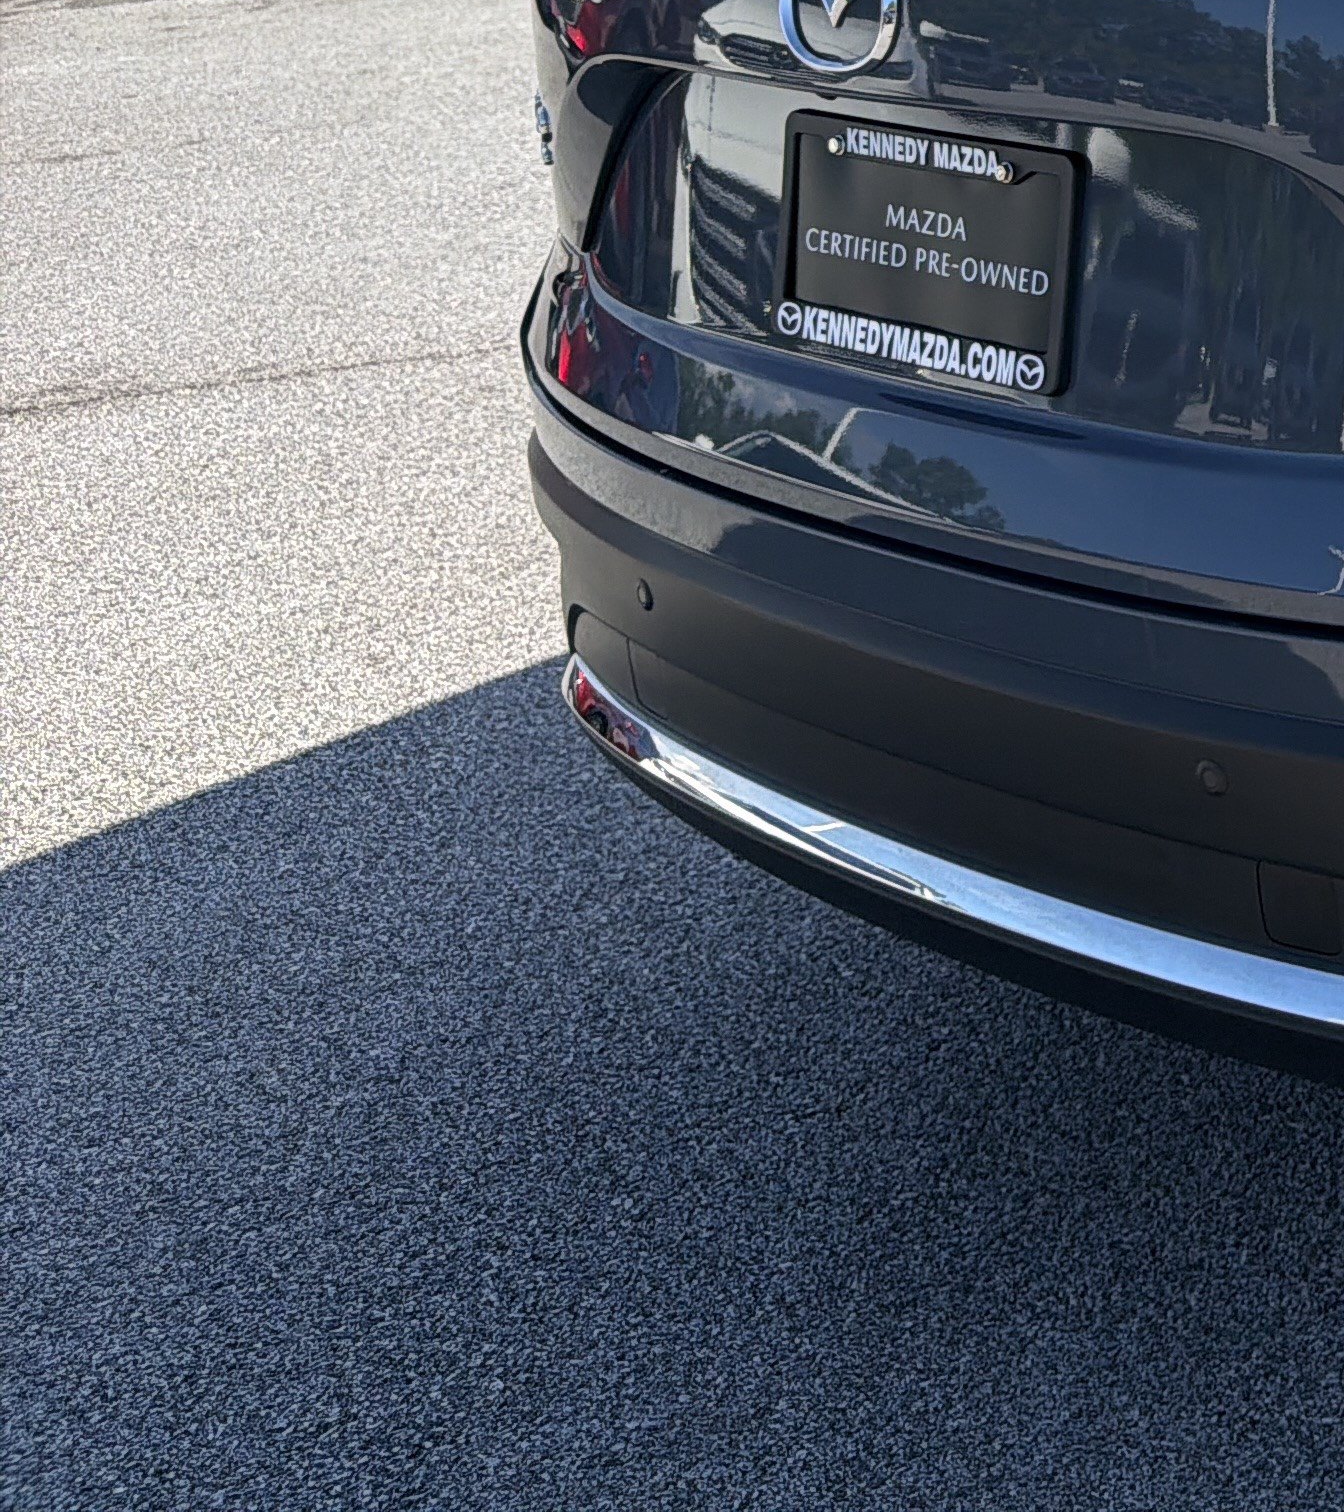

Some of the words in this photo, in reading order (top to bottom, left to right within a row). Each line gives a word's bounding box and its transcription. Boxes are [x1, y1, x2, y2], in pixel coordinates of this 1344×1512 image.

[846, 127, 930, 166] KENNEDY
[933, 141, 1000, 177] MAZDA
[885, 203, 967, 242] MAZDA
[804, 227, 907, 268] CERTIFIED
[914, 246, 1050, 296] PRE-OWNED
[802, 306, 1017, 387] KENNEDYMAZDA.COM
